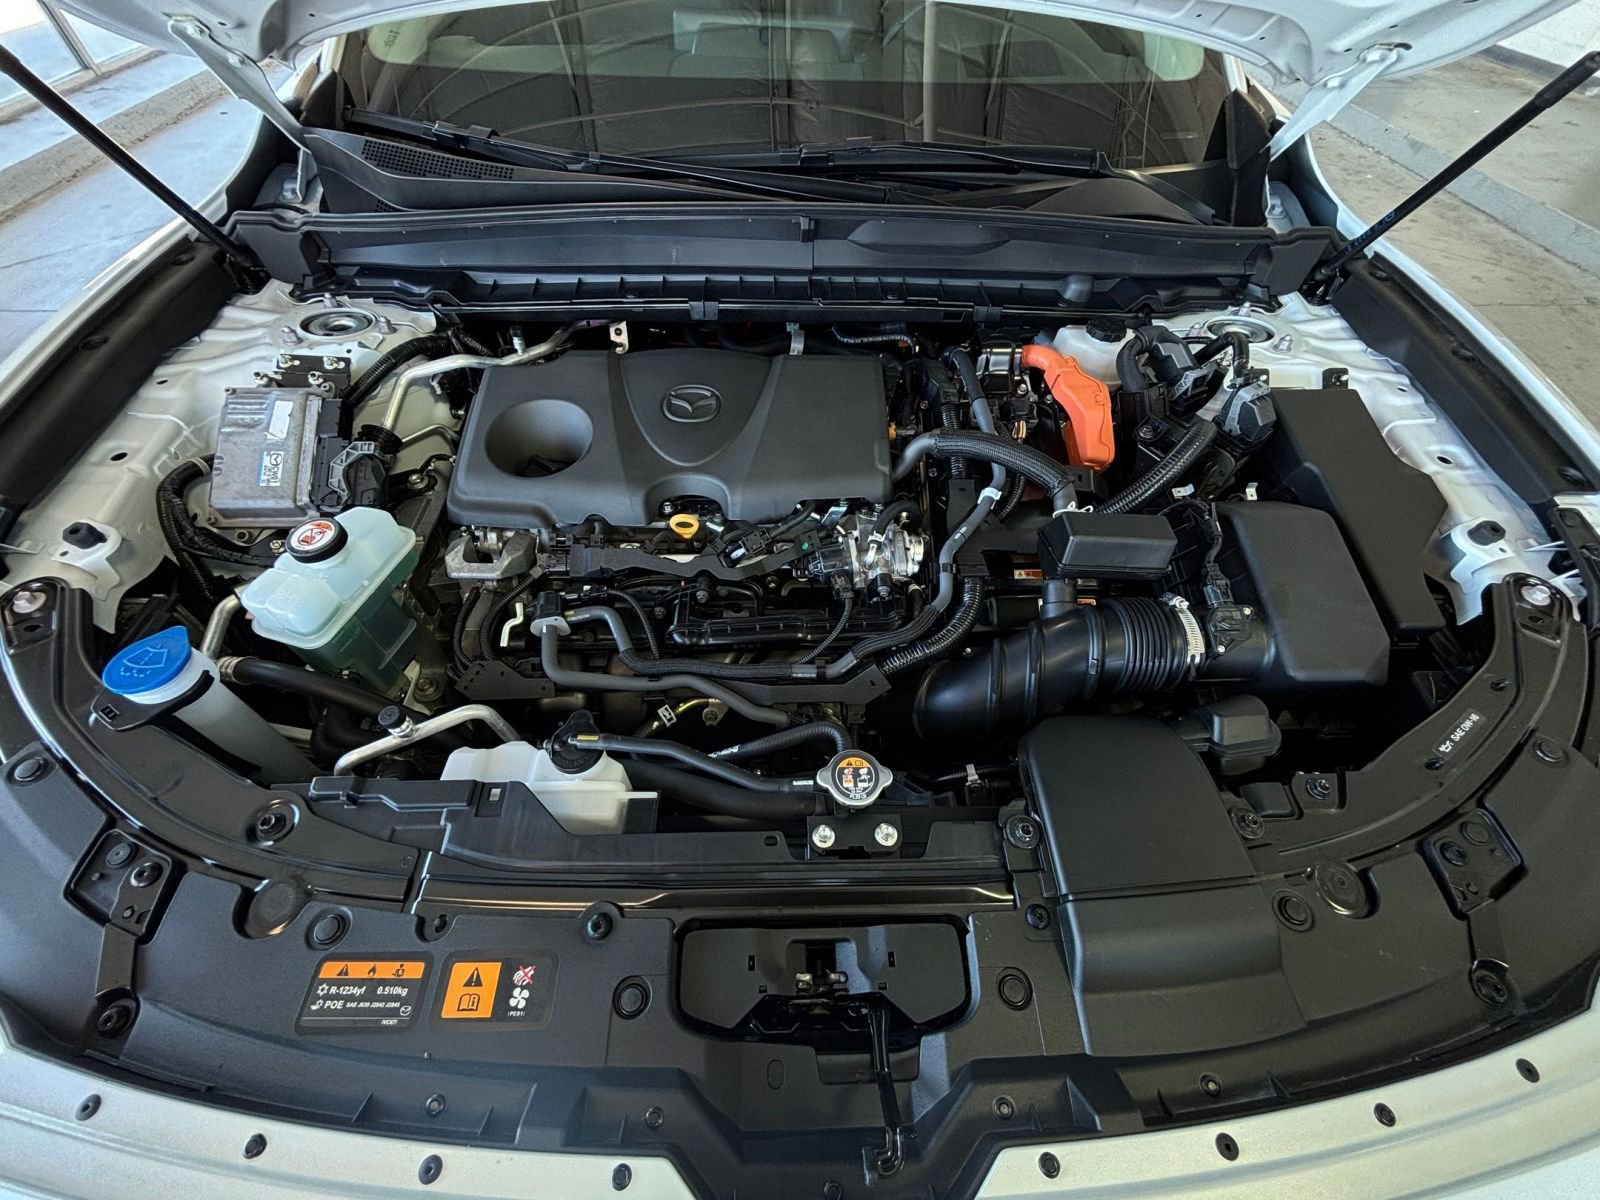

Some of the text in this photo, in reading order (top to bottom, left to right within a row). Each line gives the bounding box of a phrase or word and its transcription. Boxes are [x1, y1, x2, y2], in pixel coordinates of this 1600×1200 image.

[1450, 727, 1466, 742] SAE
[329, 986, 408, 997] R-1234yf 0.510kg
[323, 1000, 343, 1010] POE
